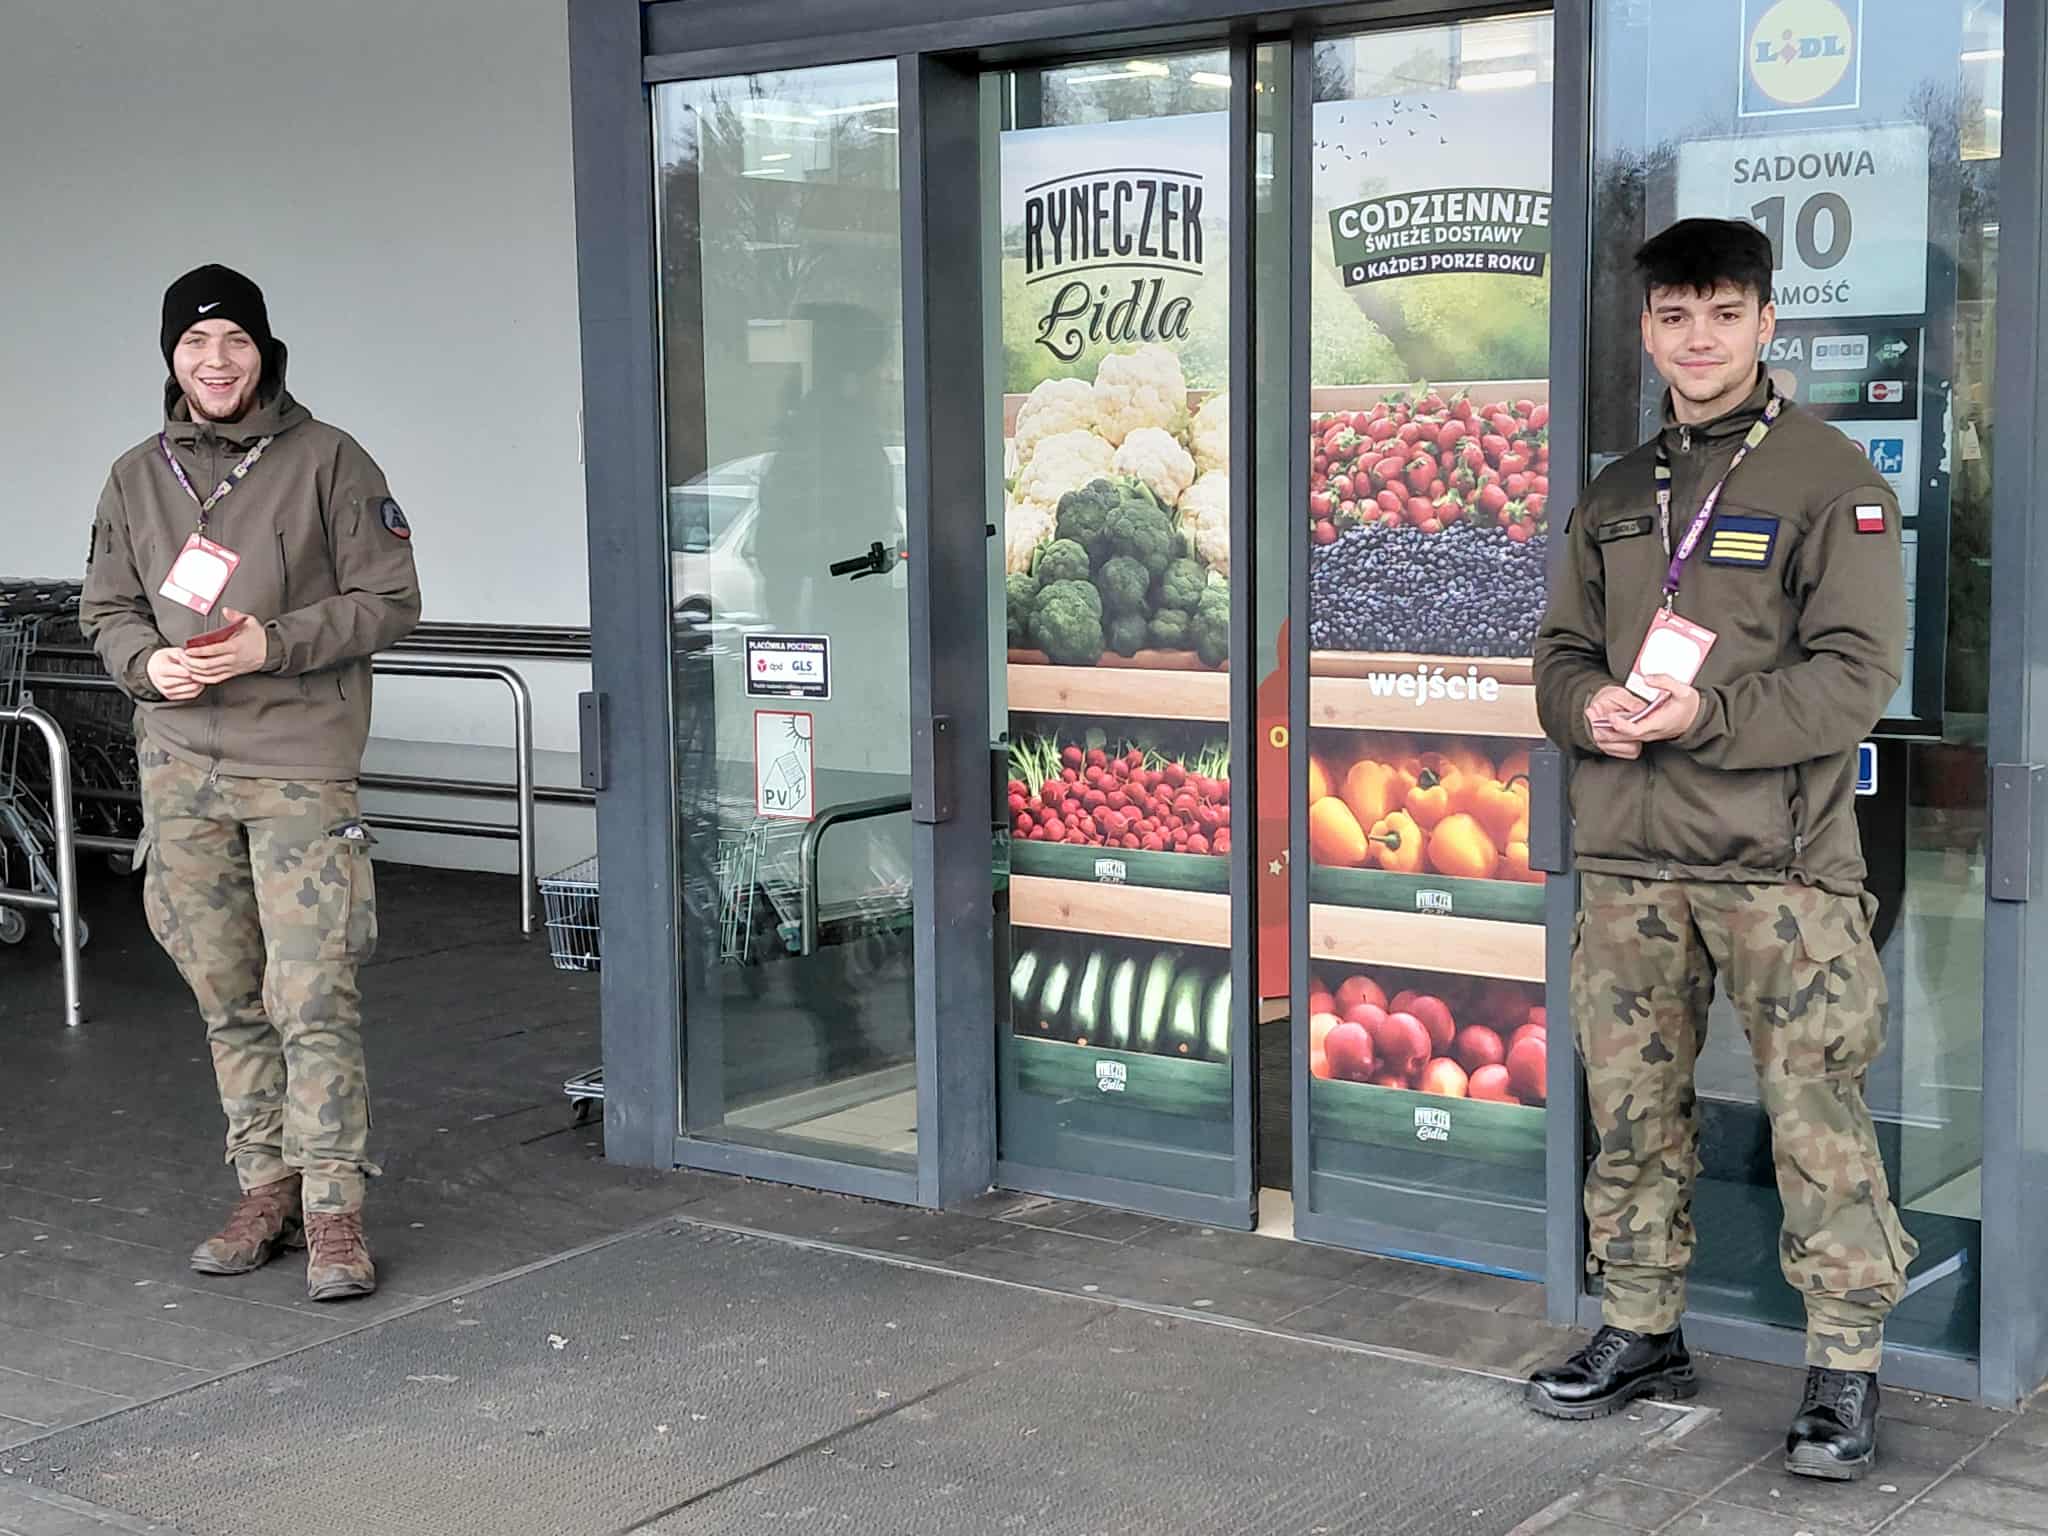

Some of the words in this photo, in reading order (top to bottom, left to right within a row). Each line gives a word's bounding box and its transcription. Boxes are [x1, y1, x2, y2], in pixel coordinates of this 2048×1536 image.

[1733, 150, 1876, 184] SADOWA
[1025, 179, 1203, 275] RYNECZEK
[1338, 192, 1552, 239] CODZIENNIE
[1751, 192, 1852, 270] 10
[1365, 226, 1430, 253] ŚWIEŻE
[1435, 225, 1523, 244] DOSTAWY
[1352, 267, 1365, 281] O
[1368, 255, 1427, 278] KAŻDEJ
[1431, 253, 1484, 270] PORZE
[1487, 254, 1535, 272] ROKU
[1771, 280, 1850, 305] AMOŚĆ
[1035, 277, 1194, 363] Lidla
[1761, 337, 1804, 361] ISA
[792, 660, 813, 672] GLS
[1367, 664, 1500, 706] wejście
[765, 789, 788, 806] PV
